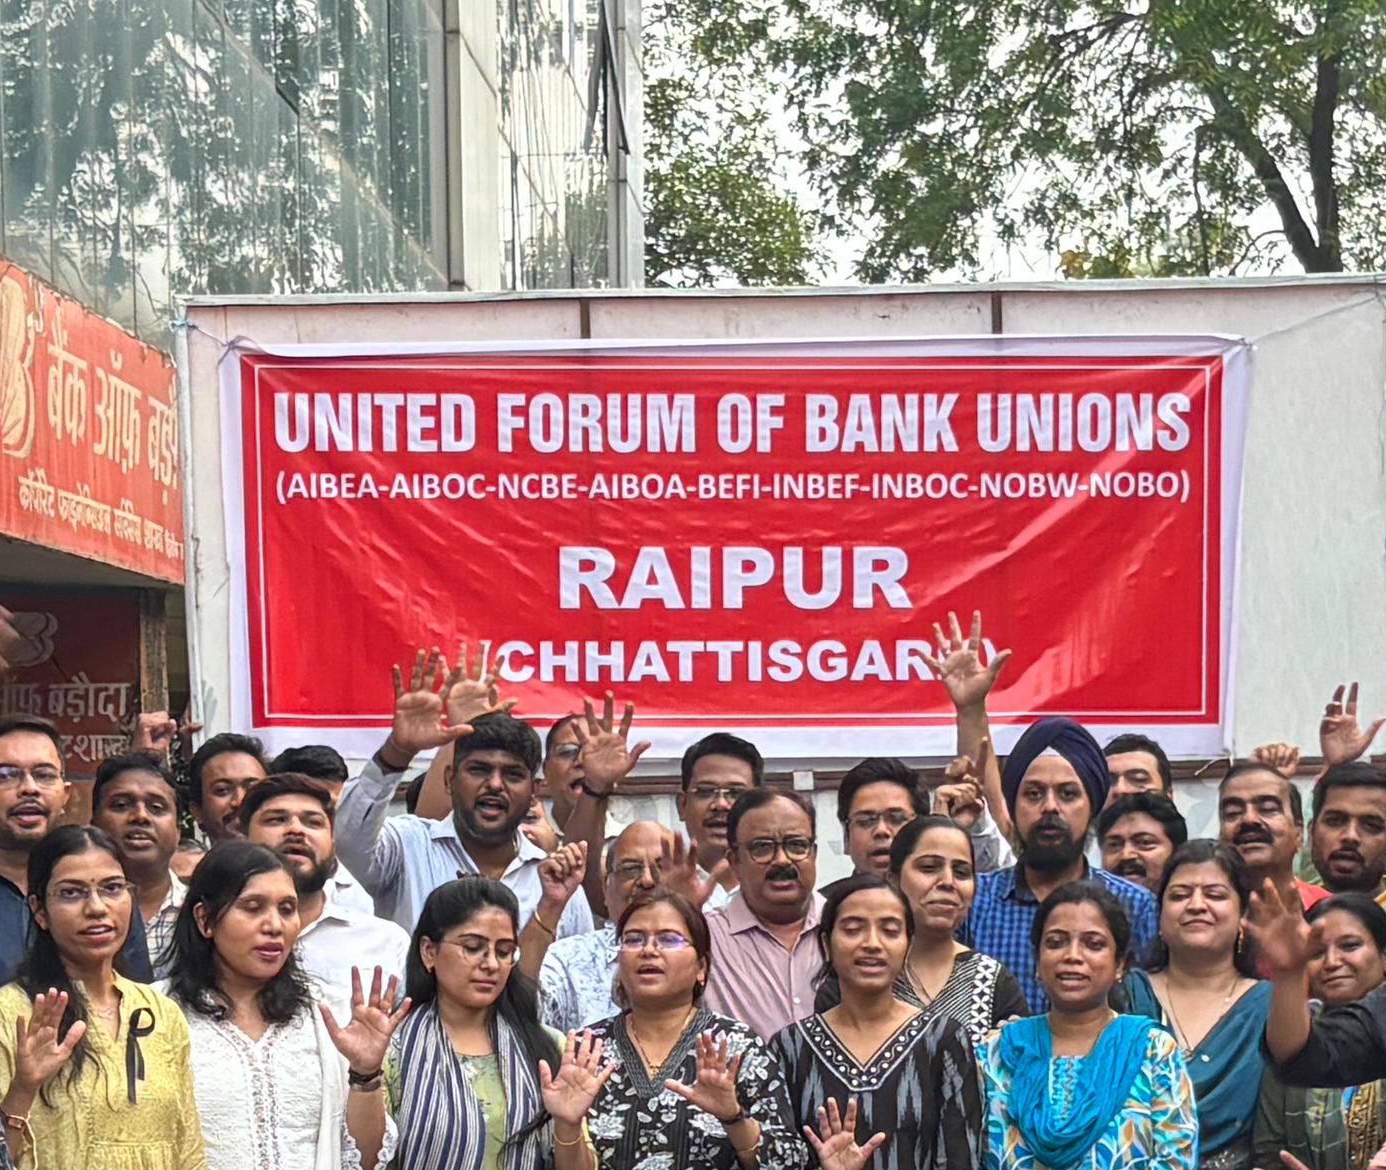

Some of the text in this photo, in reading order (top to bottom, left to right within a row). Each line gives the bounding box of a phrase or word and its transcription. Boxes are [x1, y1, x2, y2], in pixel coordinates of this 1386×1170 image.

[274, 392, 1191, 454] UNITED FORUM OF BANK UNIONS
[275, 470, 1190, 504] (AIBEA-AIBOC-NCBE-AIBOA-BEFI-INBEF-INBOC-NOBW-NOBO)
[558, 546, 913, 610] RAIPUR
[48, 671, 133, 723] बड़ौदा
